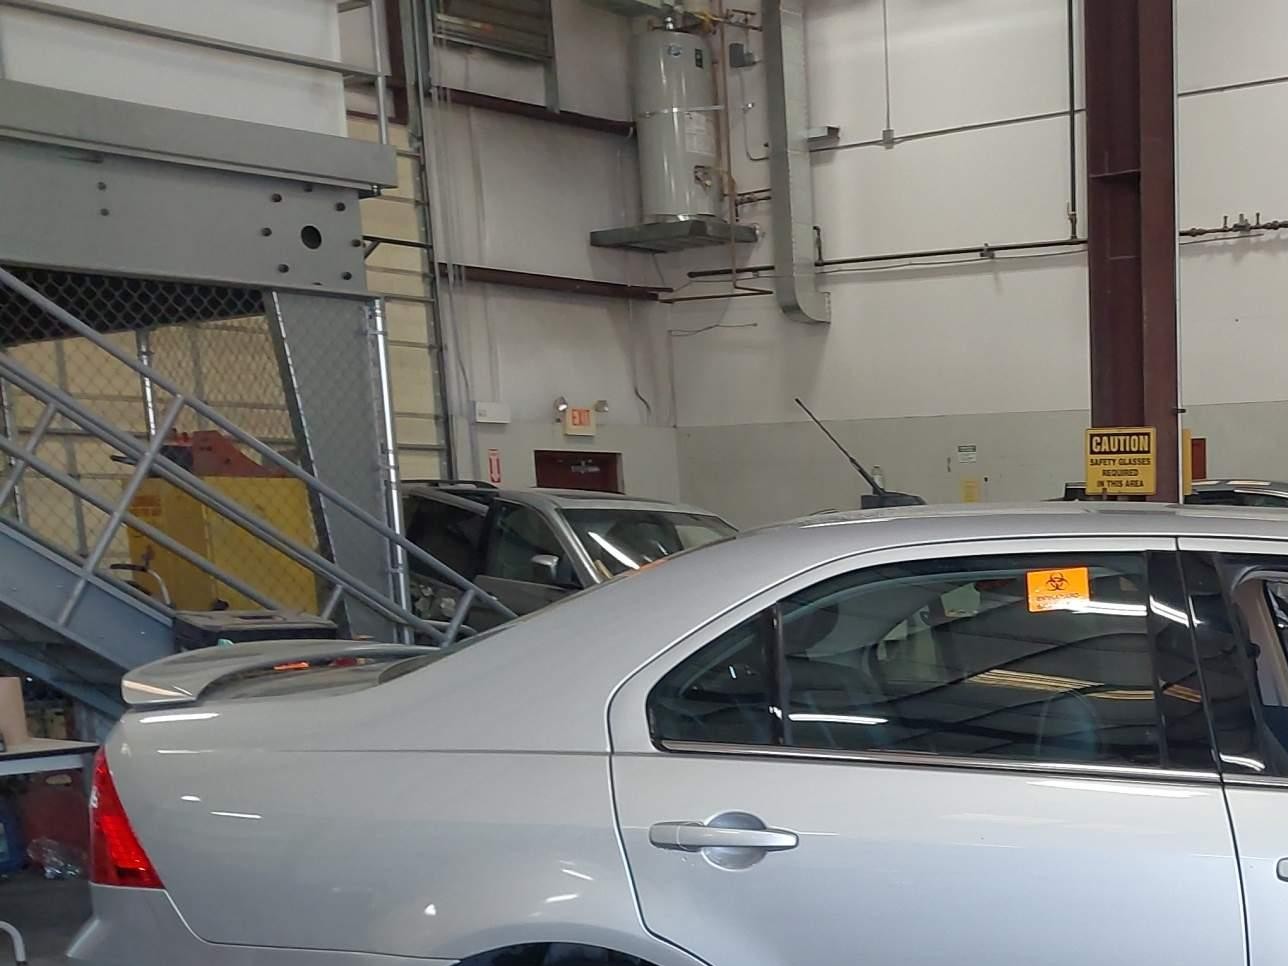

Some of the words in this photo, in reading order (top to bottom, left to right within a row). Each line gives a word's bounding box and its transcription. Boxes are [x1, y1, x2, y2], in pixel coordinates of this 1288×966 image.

[1092, 435, 1149, 452] CAUTION
[1090, 458, 1117, 466] SAFETY
[1118, 458, 1151, 466] GLASSES
[1102, 468, 1139, 477] REQUIRED
[1097, 480, 1105, 488] IN
[1106, 480, 1123, 488] THIS
[1125, 480, 1145, 488] AREA
